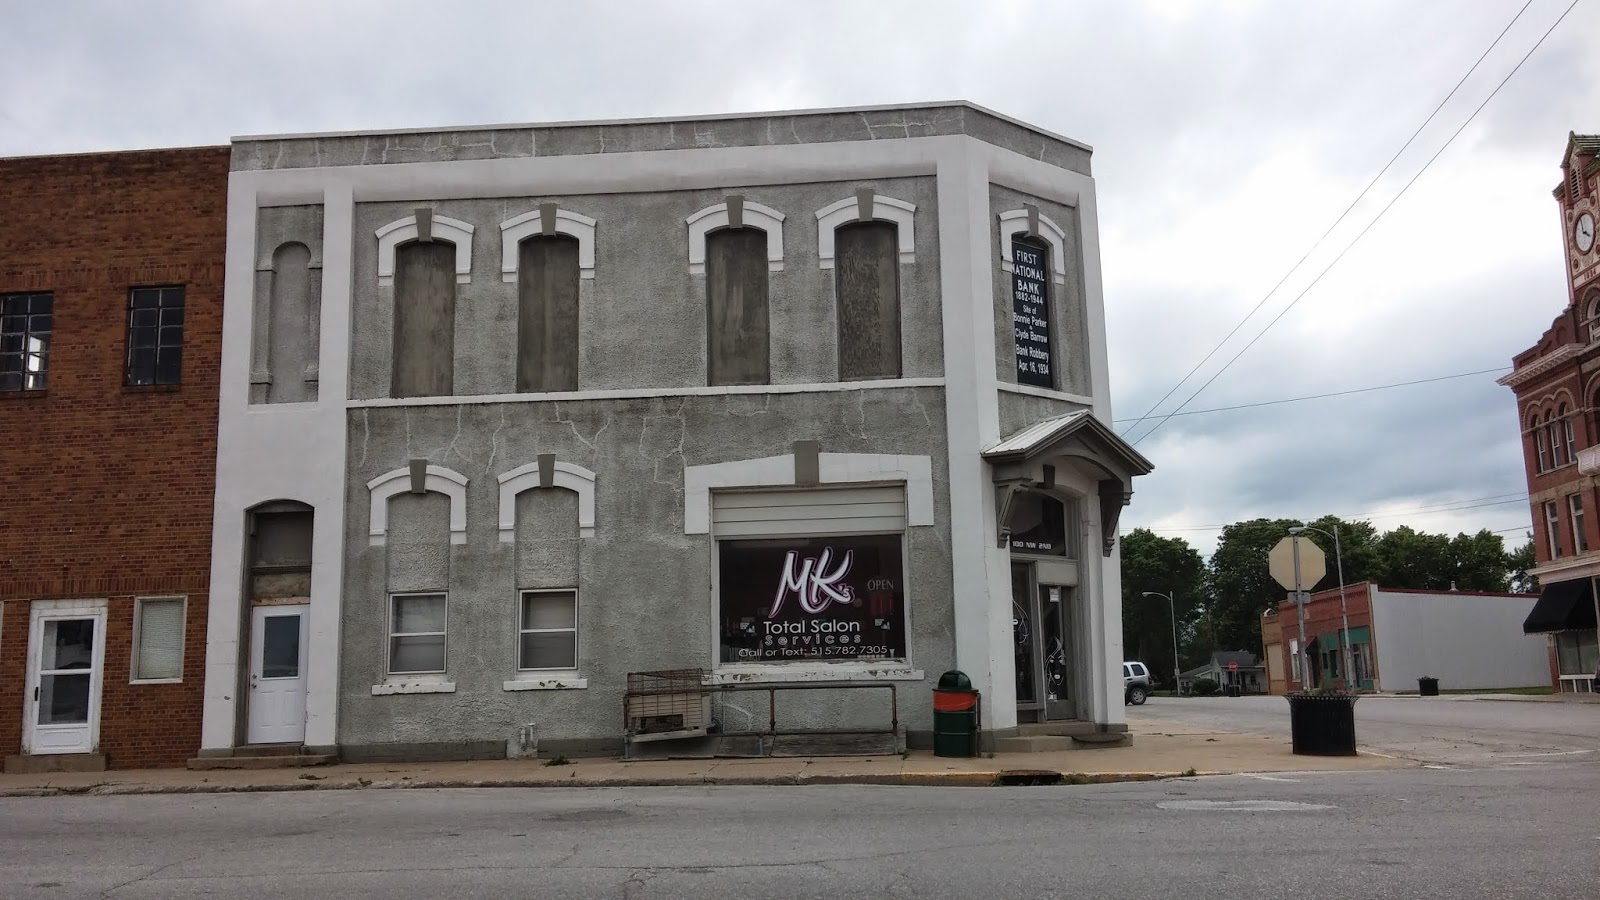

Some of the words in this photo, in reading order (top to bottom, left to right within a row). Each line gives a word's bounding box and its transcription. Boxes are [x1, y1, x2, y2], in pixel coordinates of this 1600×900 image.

[1016, 250, 1037, 265] FIRST
[1017, 279, 1039, 295] BANK
[1015, 290, 1044, 305] 1882-1944
[1022, 304, 1031, 314] Site
[1032, 306, 1037, 315] of
[1013, 312, 1030, 325] Bonnie
[1031, 316, 1047, 328] Parker
[1015, 327, 1029, 340] Clyde
[1030, 331, 1048, 343] Barrow
[1015, 343, 1028, 356] Bank
[1029, 346, 1049, 363] Robbery
[1037, 362, 1049, 375] 1934
[867, 579, 894, 590] OPEN
[763, 620, 806, 634] Total
[810, 619, 860, 633] Salon
[764, 634, 862, 646] Services
[738, 649, 762, 657] Call
[765, 649, 778, 657] or
[780, 647, 807, 656] Text:
[810, 645, 888, 656] 515.782.7305
